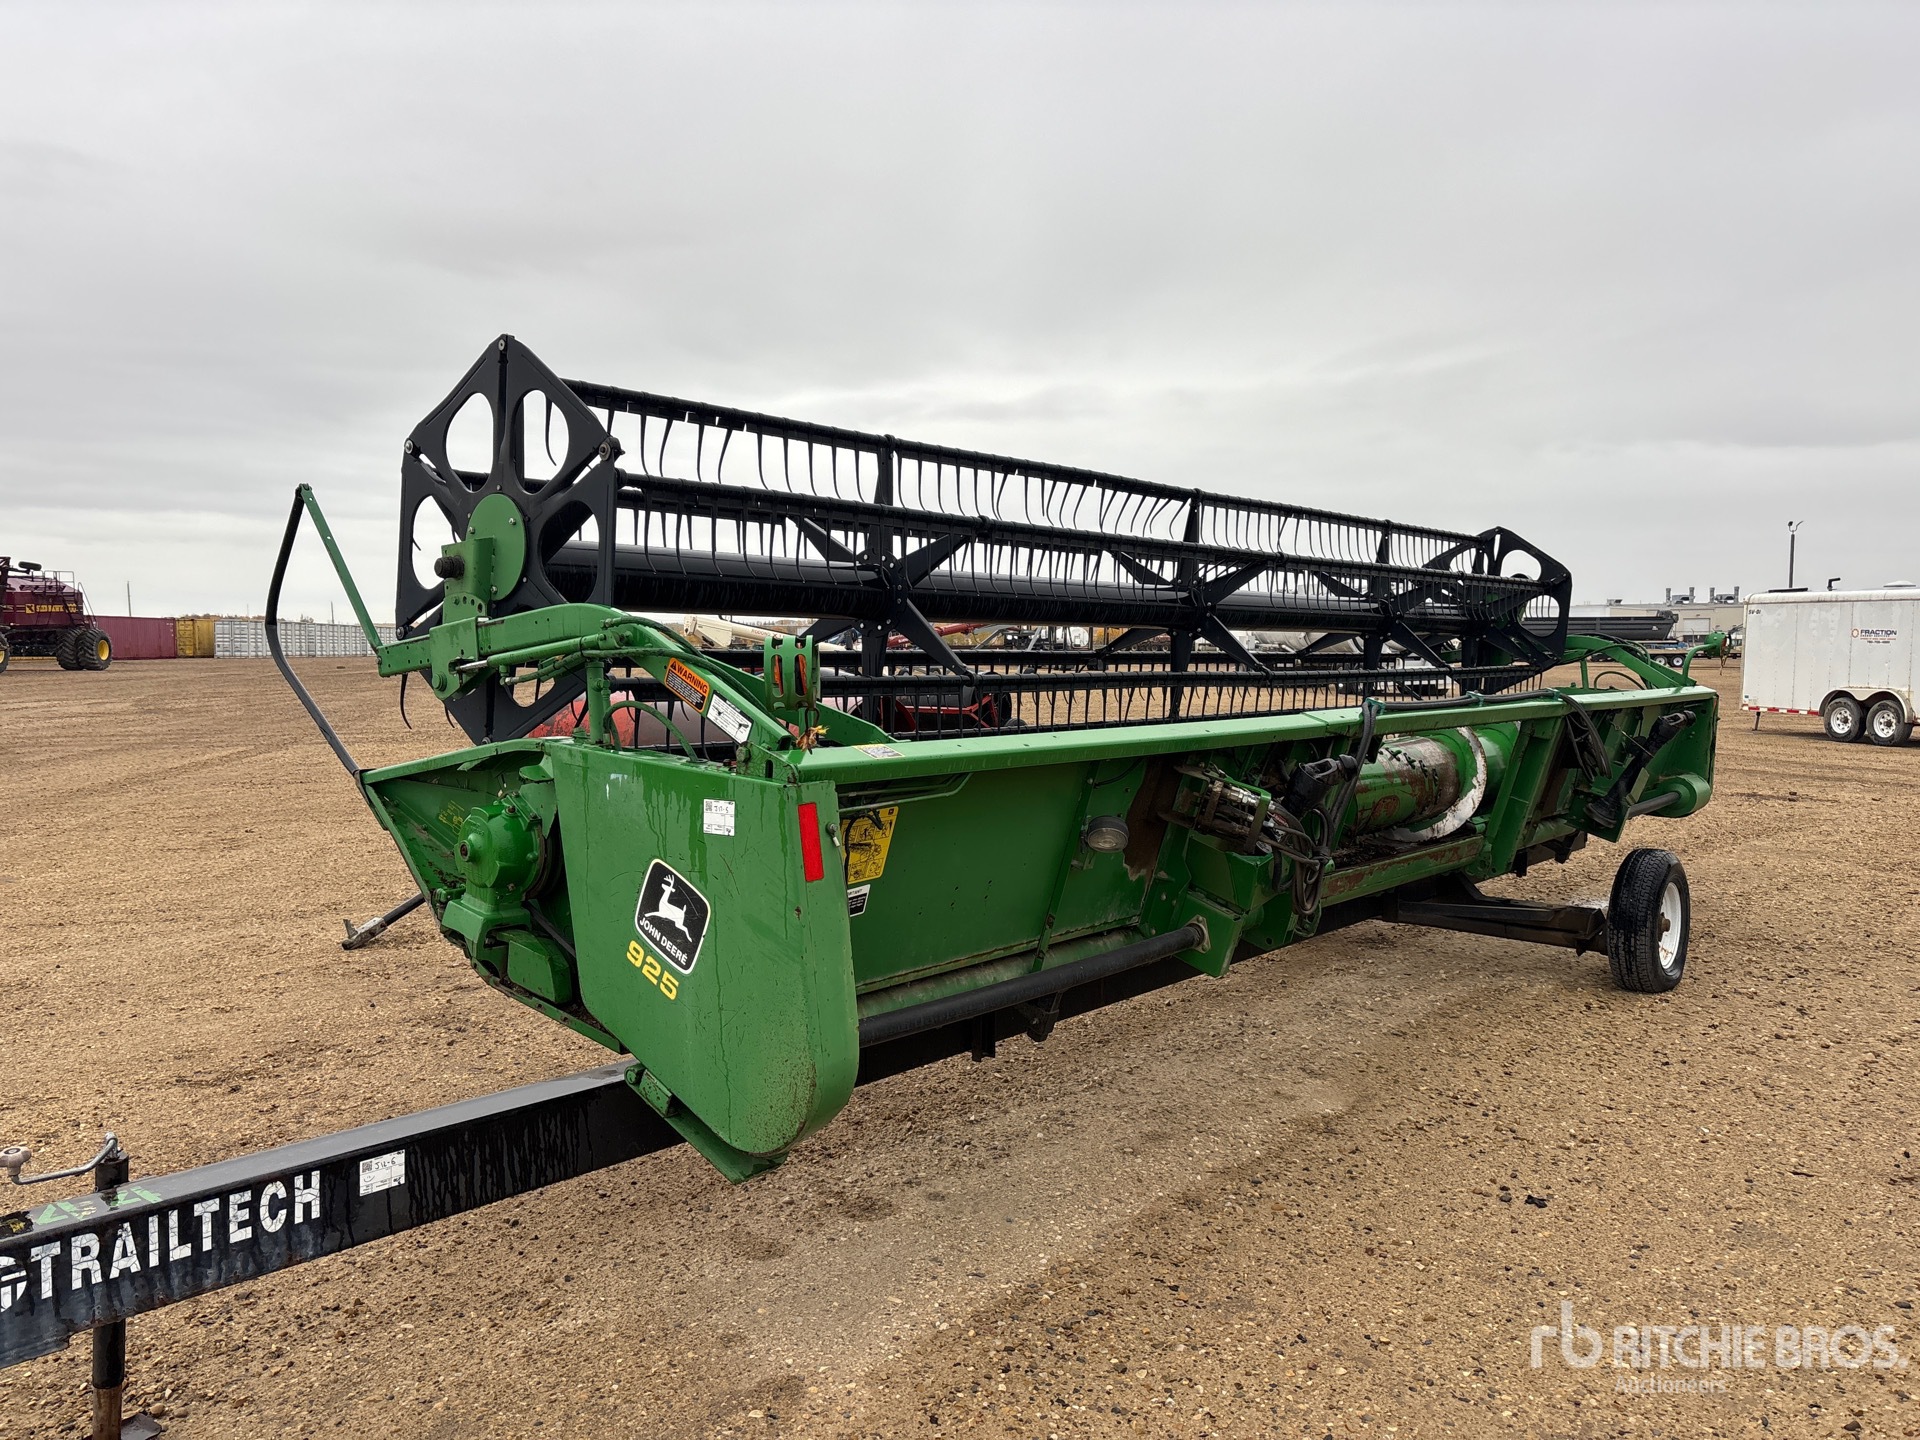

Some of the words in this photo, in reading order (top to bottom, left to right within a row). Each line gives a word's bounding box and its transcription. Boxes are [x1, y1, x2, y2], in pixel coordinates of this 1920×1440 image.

[677, 664, 708, 693] WARNING
[639, 917, 661, 942] JOHN
[660, 935, 688, 966] DEERE
[626, 939, 679, 1001] 925
[30, 1170, 321, 1300] TRAILTECH
